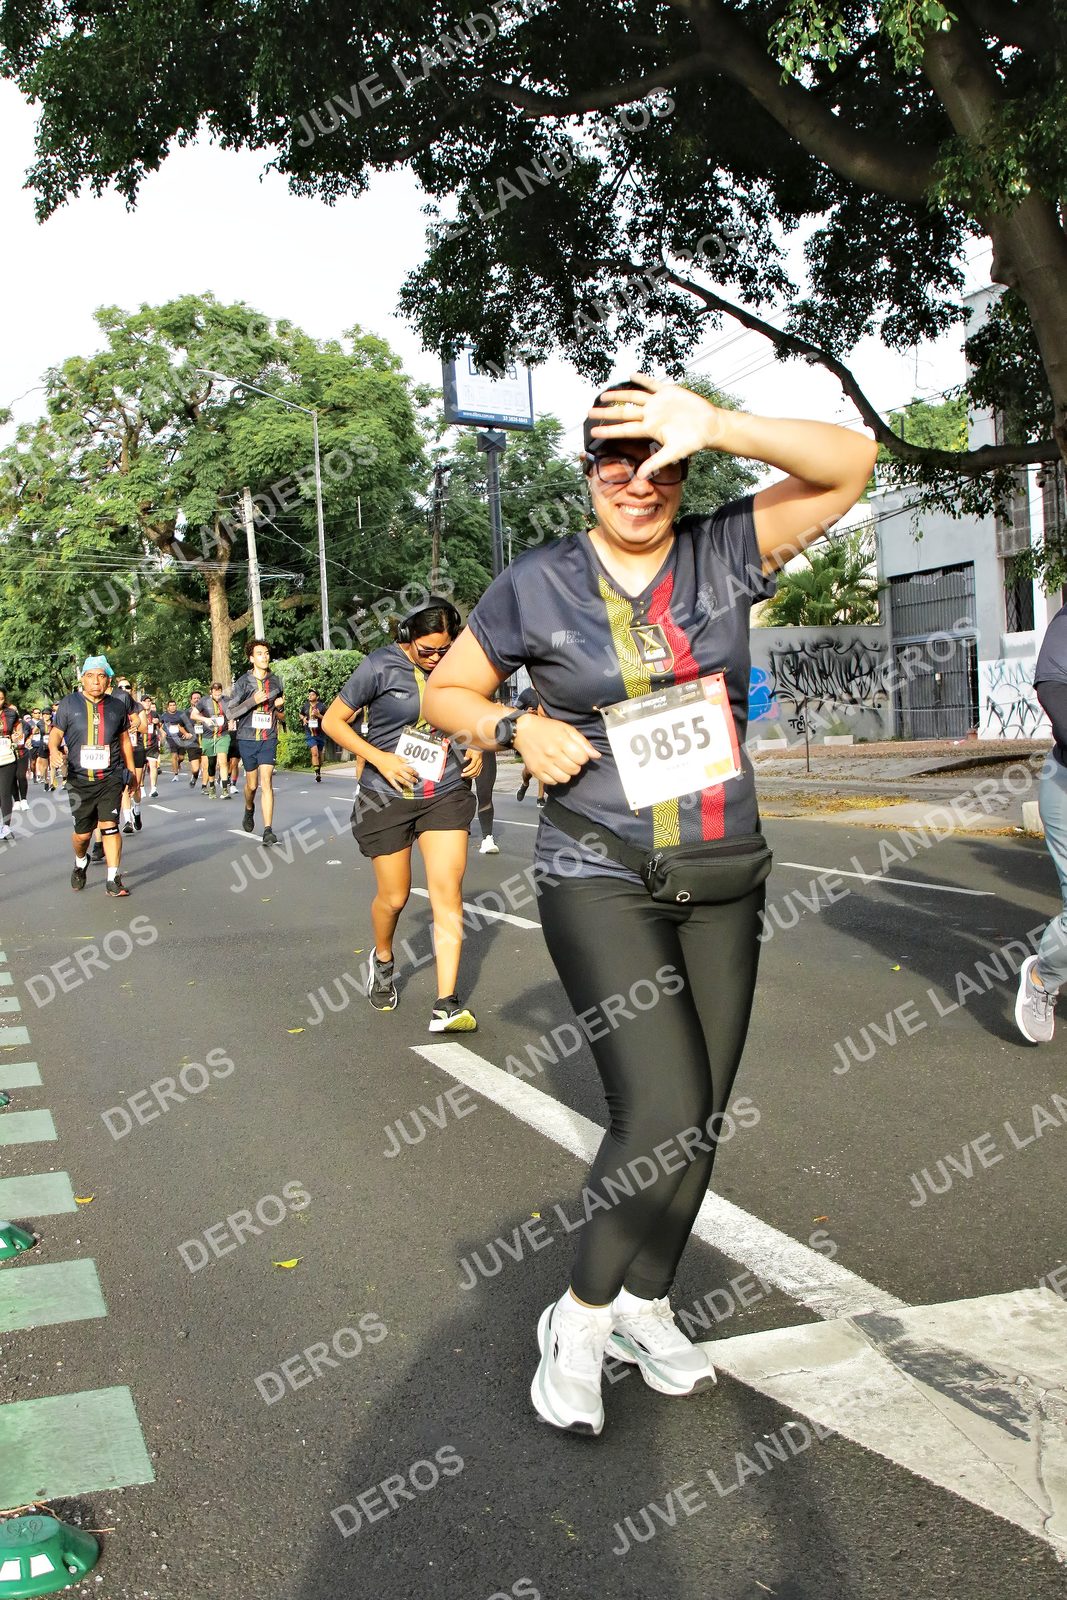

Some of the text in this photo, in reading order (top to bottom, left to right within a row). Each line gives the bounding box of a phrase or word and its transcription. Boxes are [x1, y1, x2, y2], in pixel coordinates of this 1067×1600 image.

[630, 715, 711, 768] 9855
[84, 753, 105, 761] 9078
[403, 742, 439, 764] 8005
